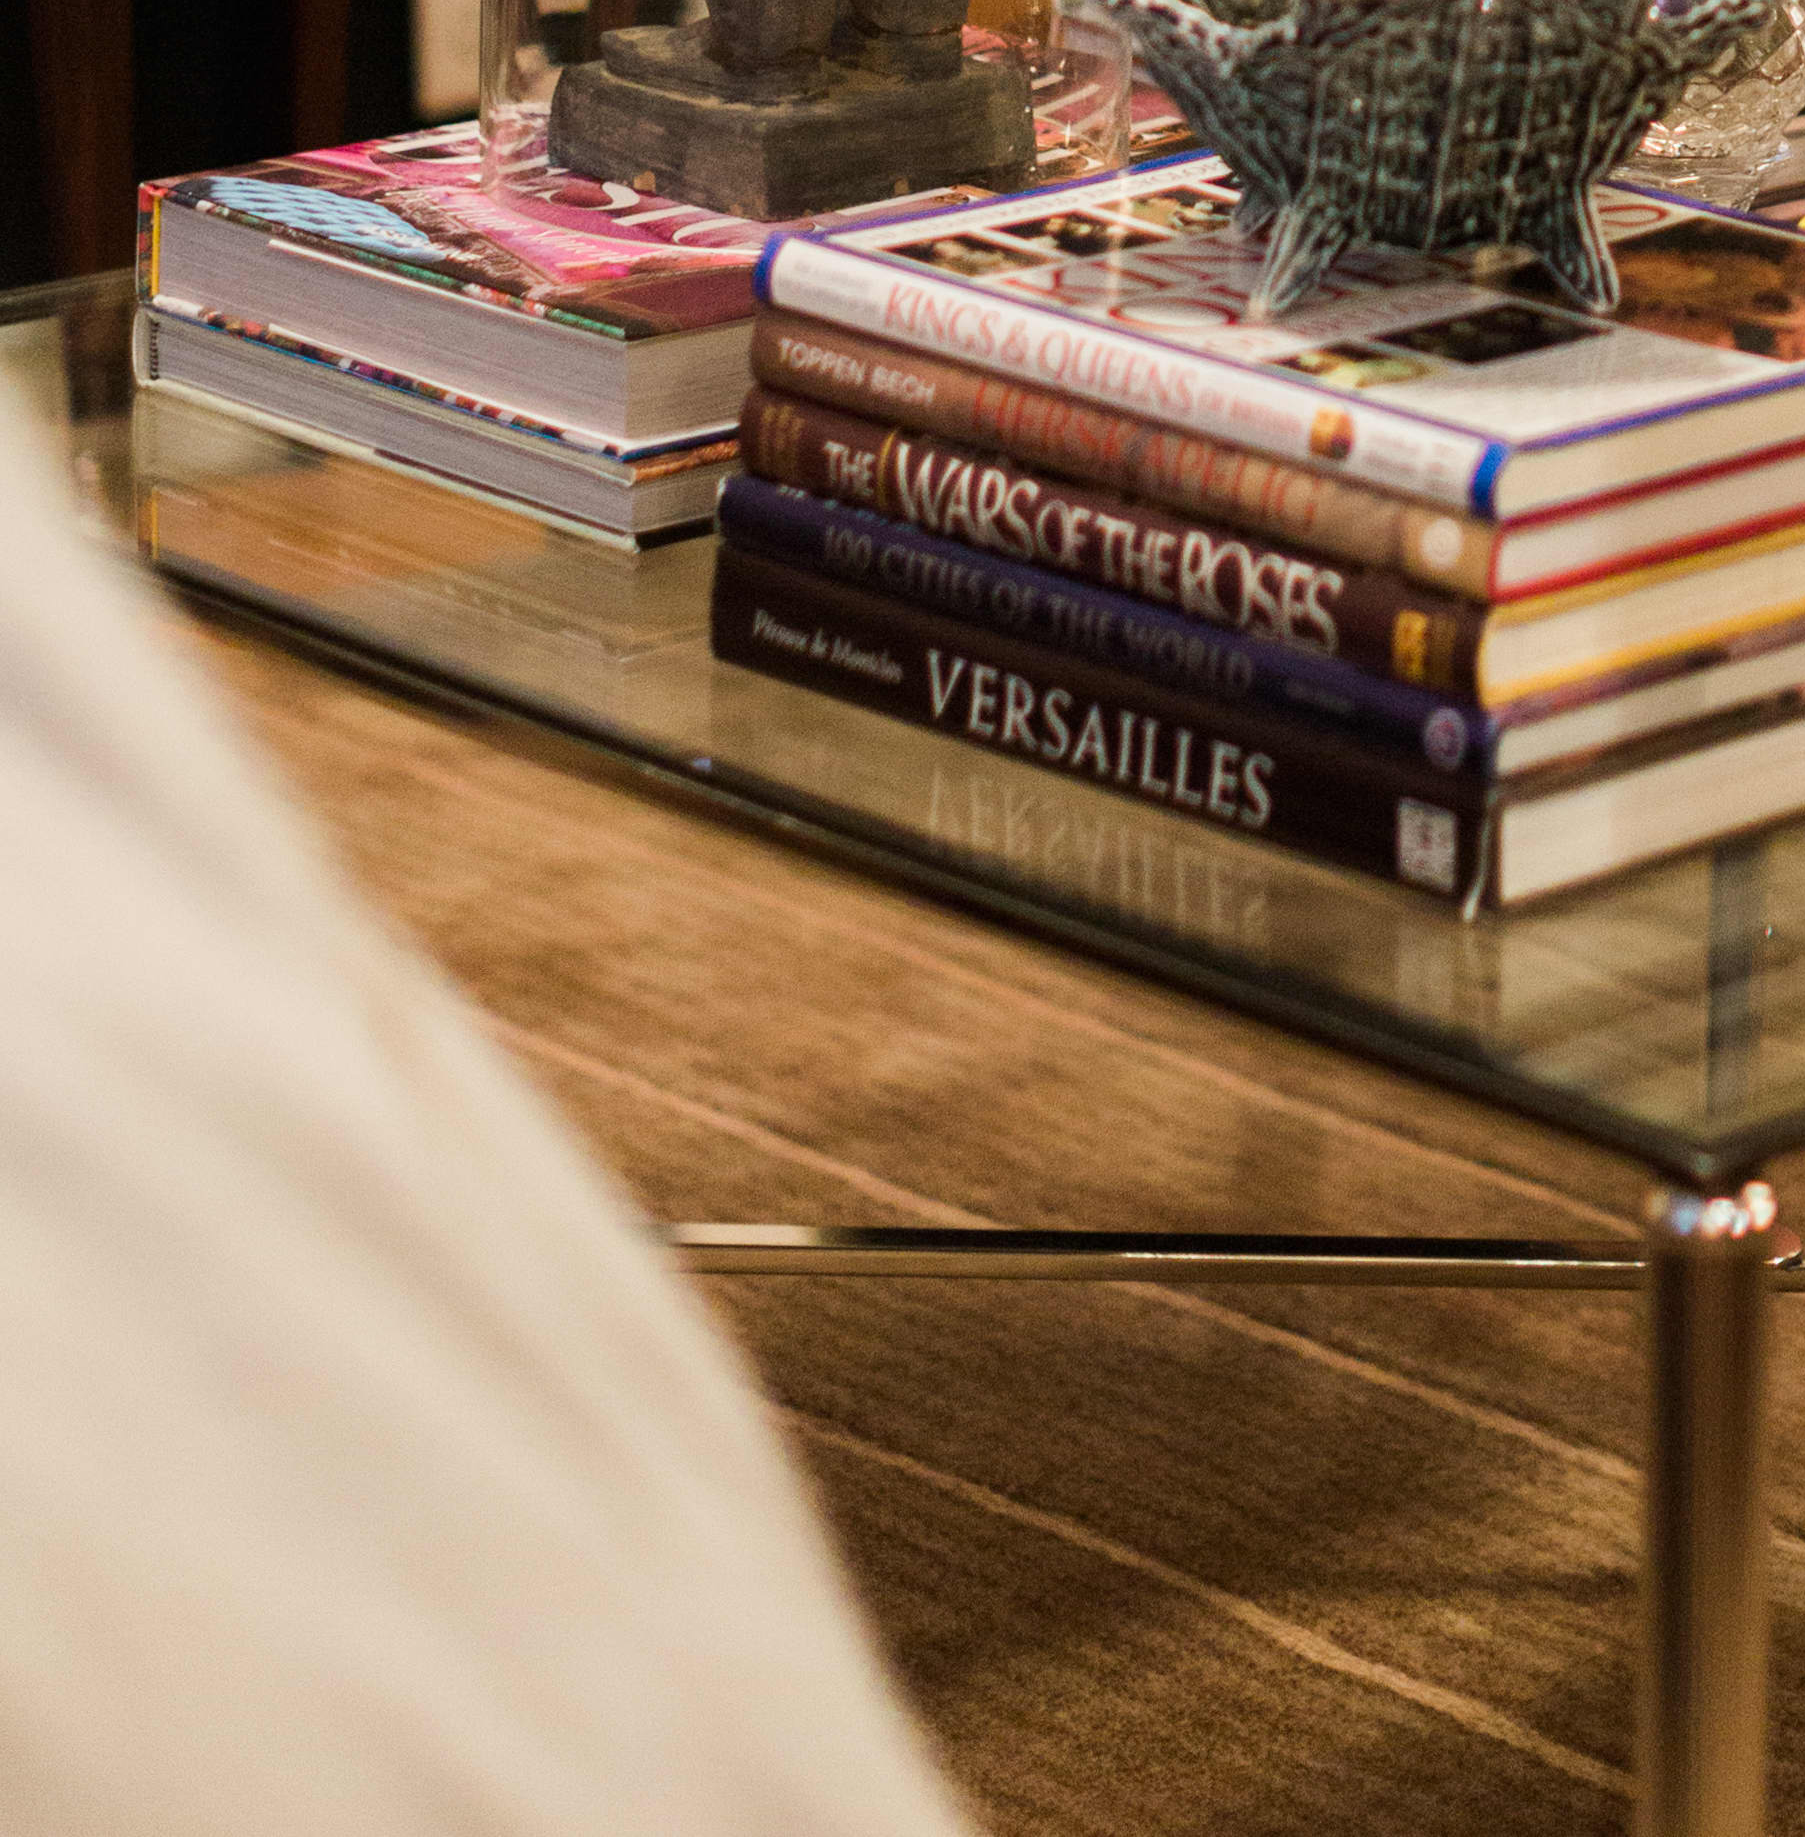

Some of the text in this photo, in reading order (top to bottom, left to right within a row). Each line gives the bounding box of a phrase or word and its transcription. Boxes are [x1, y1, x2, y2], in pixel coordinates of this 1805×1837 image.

[779, 336, 865, 385] TOPPEN
[883, 280, 1002, 360] KINGS
[1001, 317, 1031, 368] &
[1036, 326, 1198, 412] QUEENS
[824, 439, 878, 499] THE
[896, 440, 1042, 563] WARS
[1033, 498, 1092, 571] OF
[1094, 512, 1178, 602] THE
[1180, 530, 1344, 661] ROSES
[990, 577, 1040, 629] OF
[1045, 590, 1117, 652] THE
[1119, 613, 1254, 691] WORLD
[926, 647, 1276, 828] VERSAILLES
